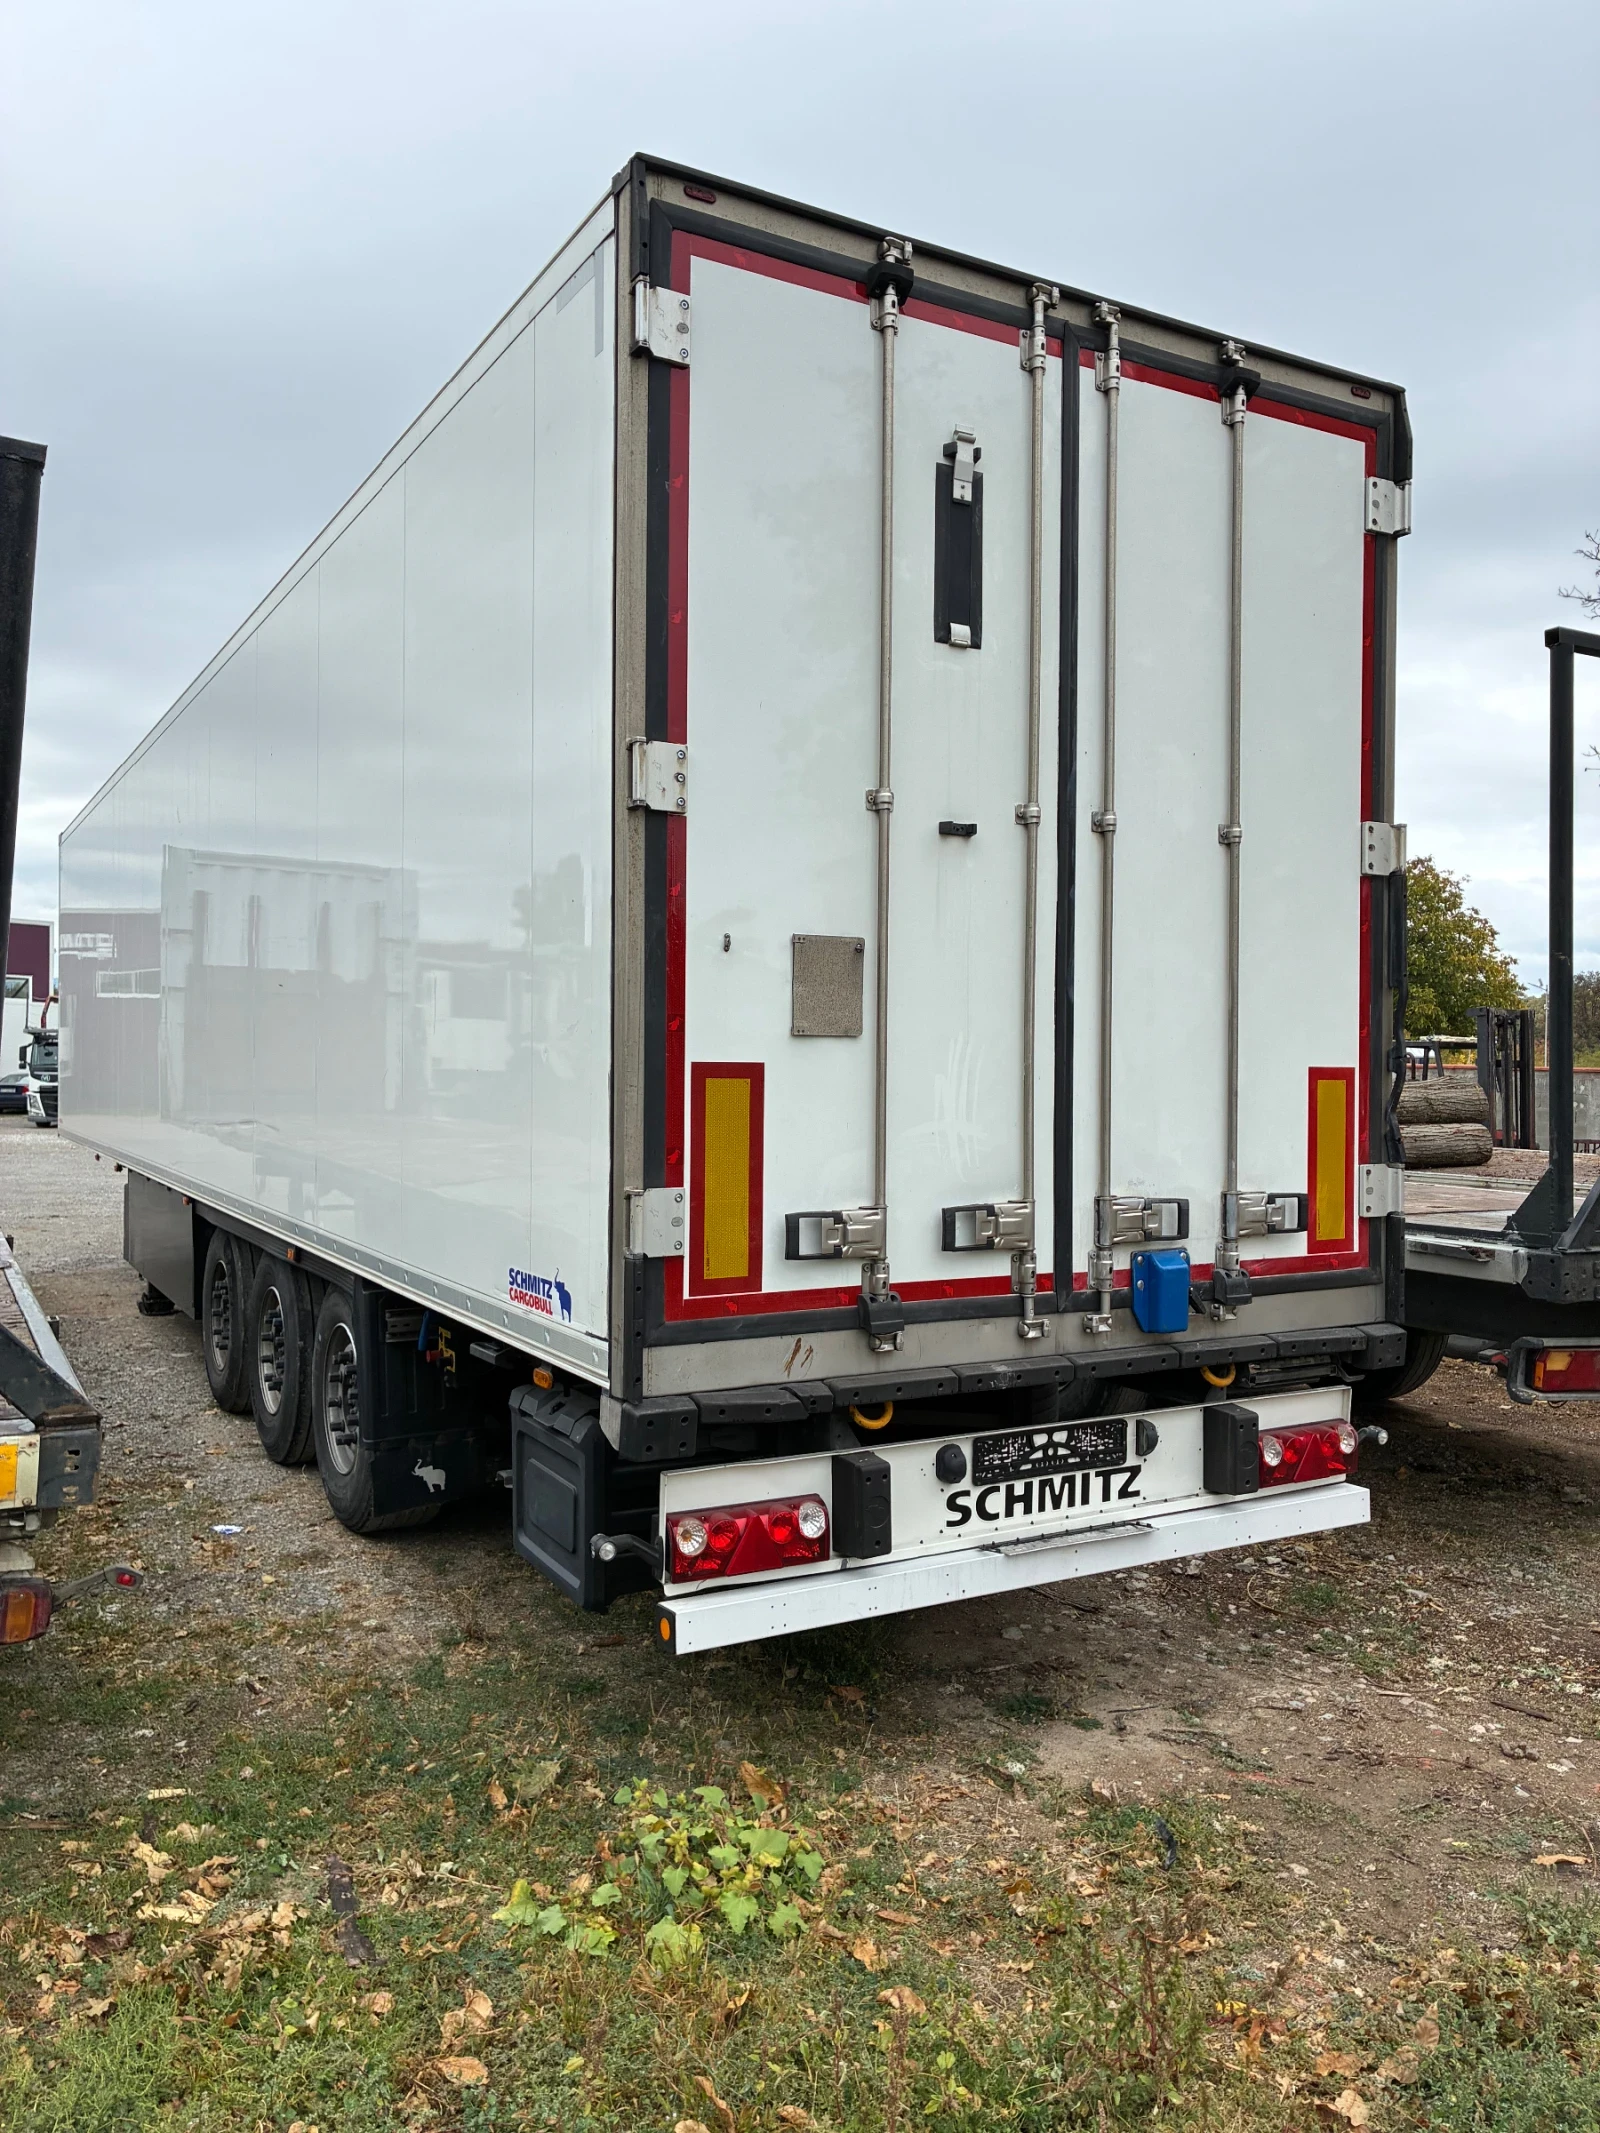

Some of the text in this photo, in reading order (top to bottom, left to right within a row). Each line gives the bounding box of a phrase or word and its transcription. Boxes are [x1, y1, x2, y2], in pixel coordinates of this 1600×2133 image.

[508, 1267, 553, 1300] SCHMITZ
[508, 1287, 553, 1316] CARGOBULL
[945, 1464, 1142, 1528] SCHMITZ
